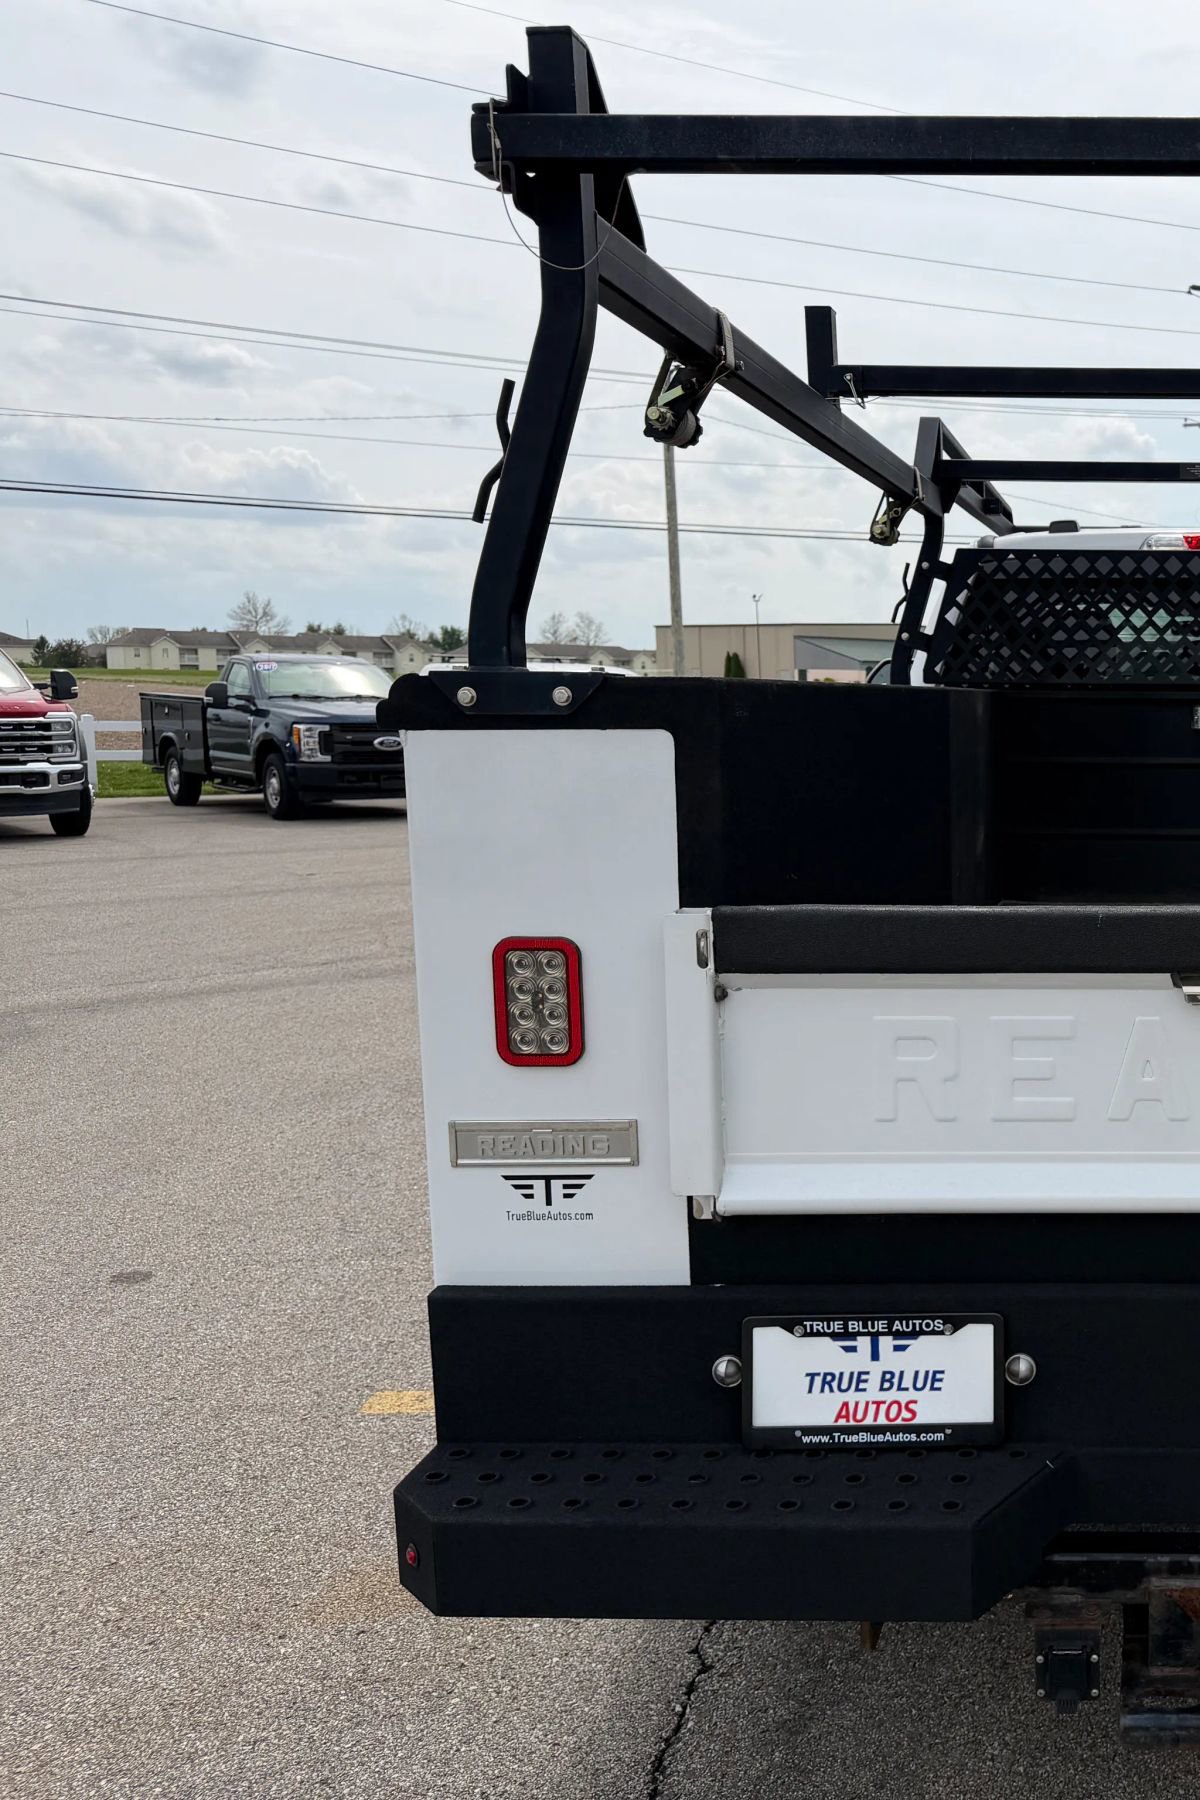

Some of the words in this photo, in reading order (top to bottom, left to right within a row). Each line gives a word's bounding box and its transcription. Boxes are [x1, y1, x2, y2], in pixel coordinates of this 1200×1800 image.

[477, 1135, 611, 1157] READING
[506, 1211, 594, 1221] TrueBlueAutos.com
[804, 1321, 845, 1333] TRUE
[848, 1320, 888, 1332] BLUE
[892, 1319, 944, 1332] AUTOS
[804, 1371, 869, 1394] TRUE
[879, 1369, 945, 1392] BLUE
[834, 1400, 918, 1424] AUTOS
[802, 1432, 944, 1444] www.TrueBlueAutos.com
